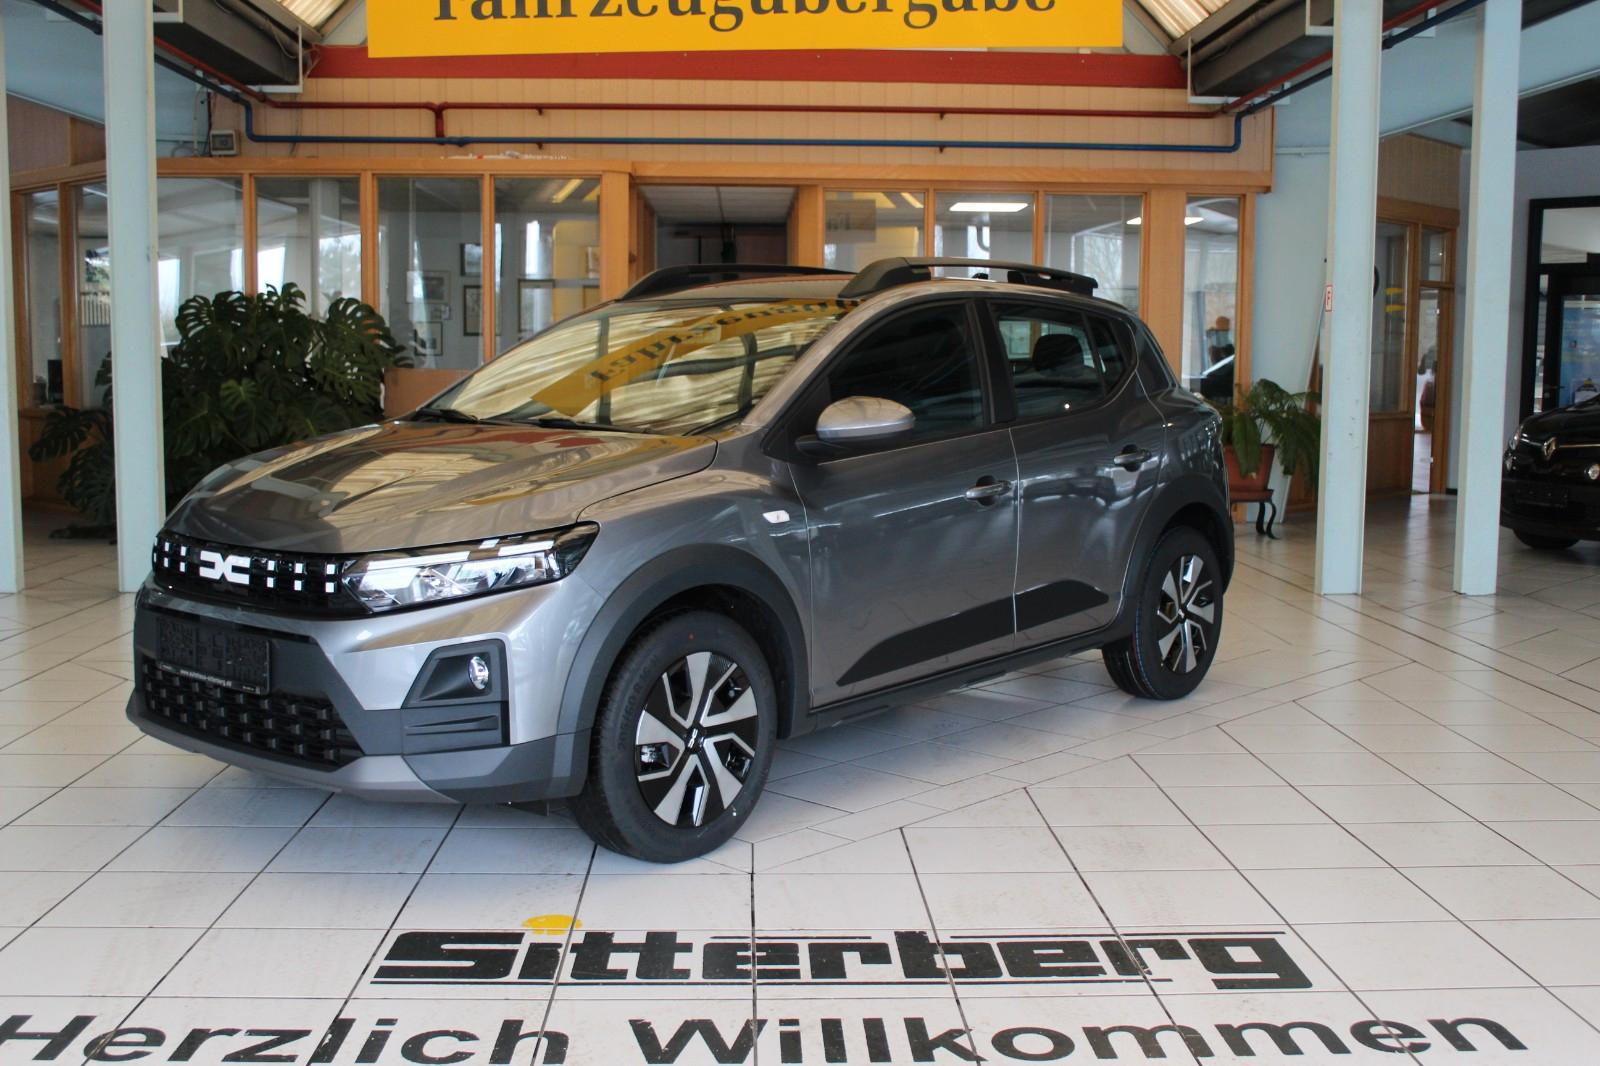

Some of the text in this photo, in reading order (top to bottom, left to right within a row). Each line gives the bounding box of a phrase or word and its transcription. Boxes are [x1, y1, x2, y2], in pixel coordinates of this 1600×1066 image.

[433, 0, 1057, 32] Farzeugg
[376, 914, 1313, 990] Sitterberg
[0, 1014, 1530, 1066] Herzlich Willkommen
